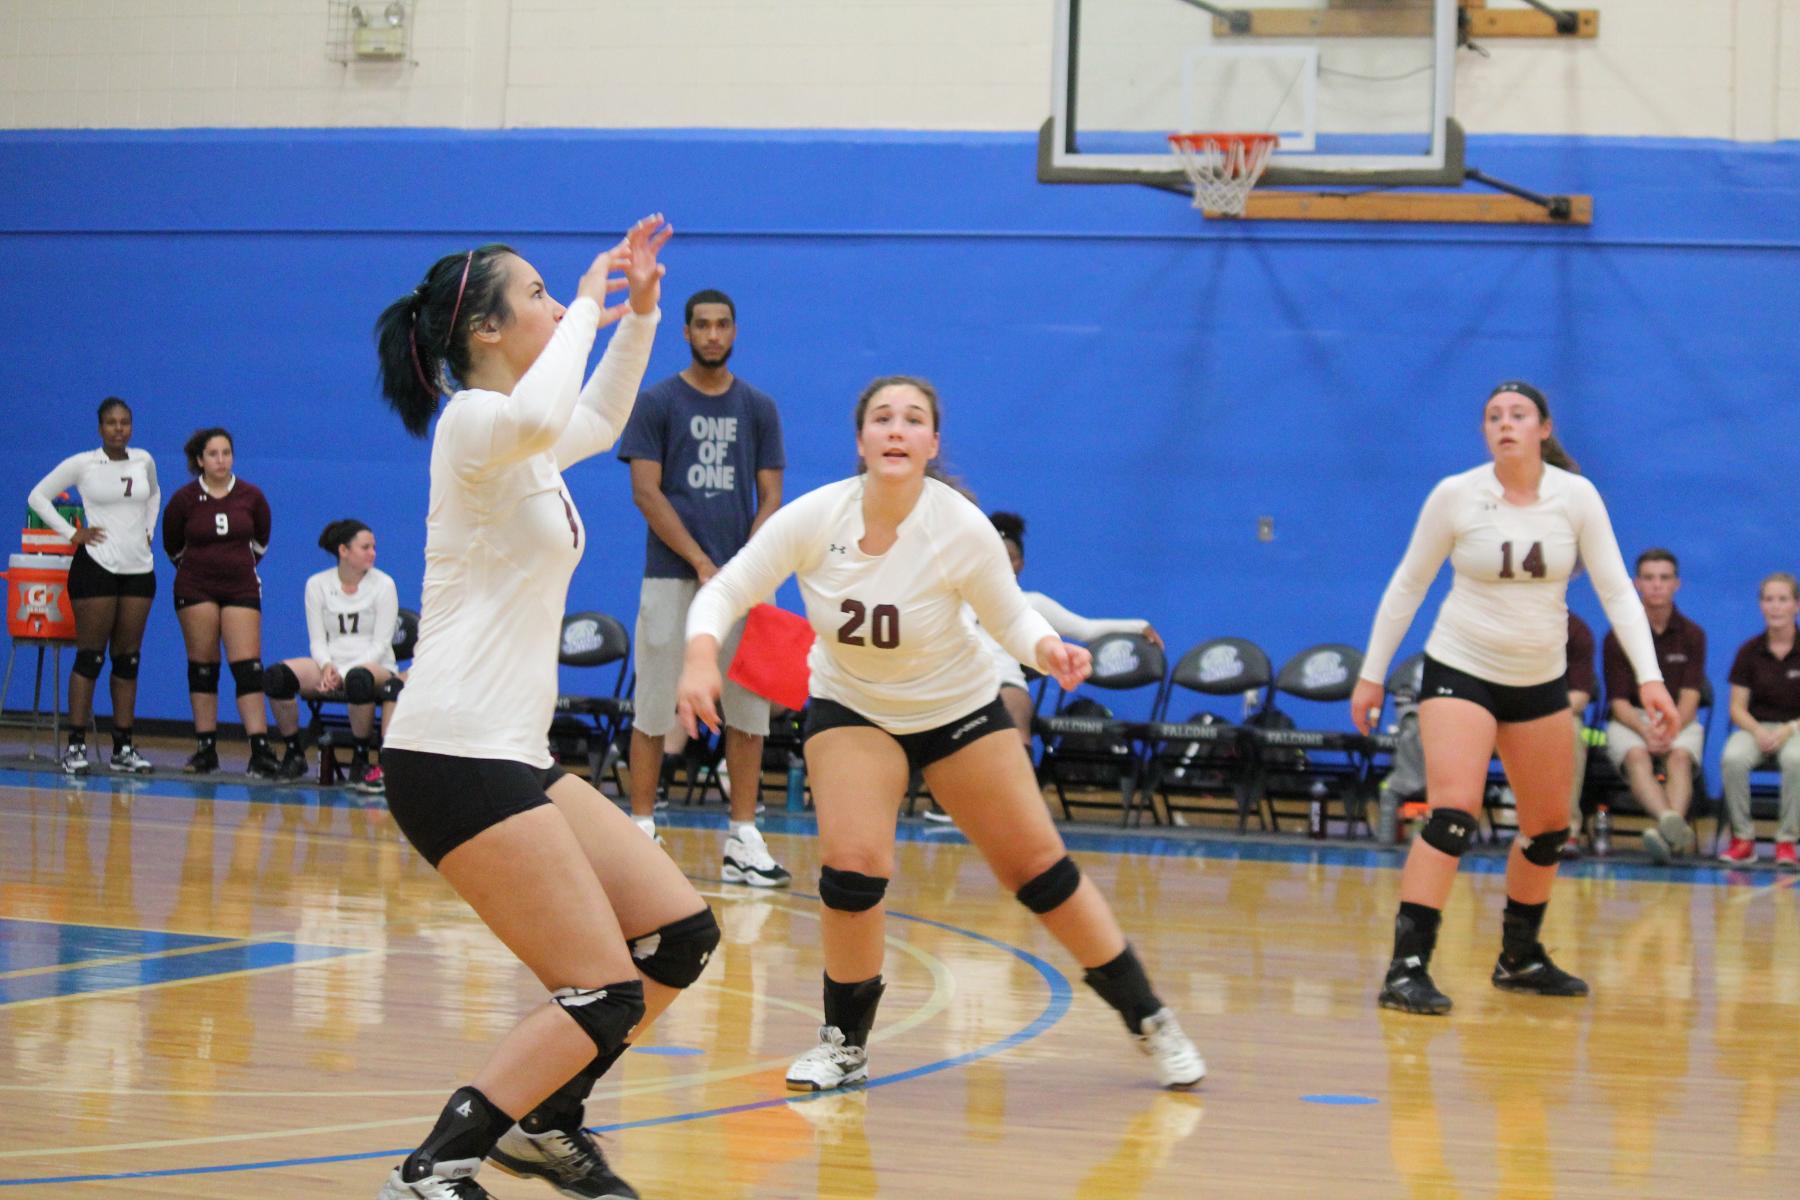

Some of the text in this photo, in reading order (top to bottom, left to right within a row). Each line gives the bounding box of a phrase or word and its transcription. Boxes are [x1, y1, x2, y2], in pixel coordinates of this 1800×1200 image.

[690, 415, 738, 441] ONE
[698, 440, 729, 465] OF
[120, 477, 134, 497] 7
[687, 463, 735, 490] ONE
[215, 513, 229, 535] 9
[1498, 541, 1547, 579] 14
[28, 584, 47, 605] G
[338, 612, 360, 634] 17
[838, 598, 901, 650] 20
[1161, 723, 1218, 739] FALCONS
[1267, 731, 1324, 745] FALCONS
